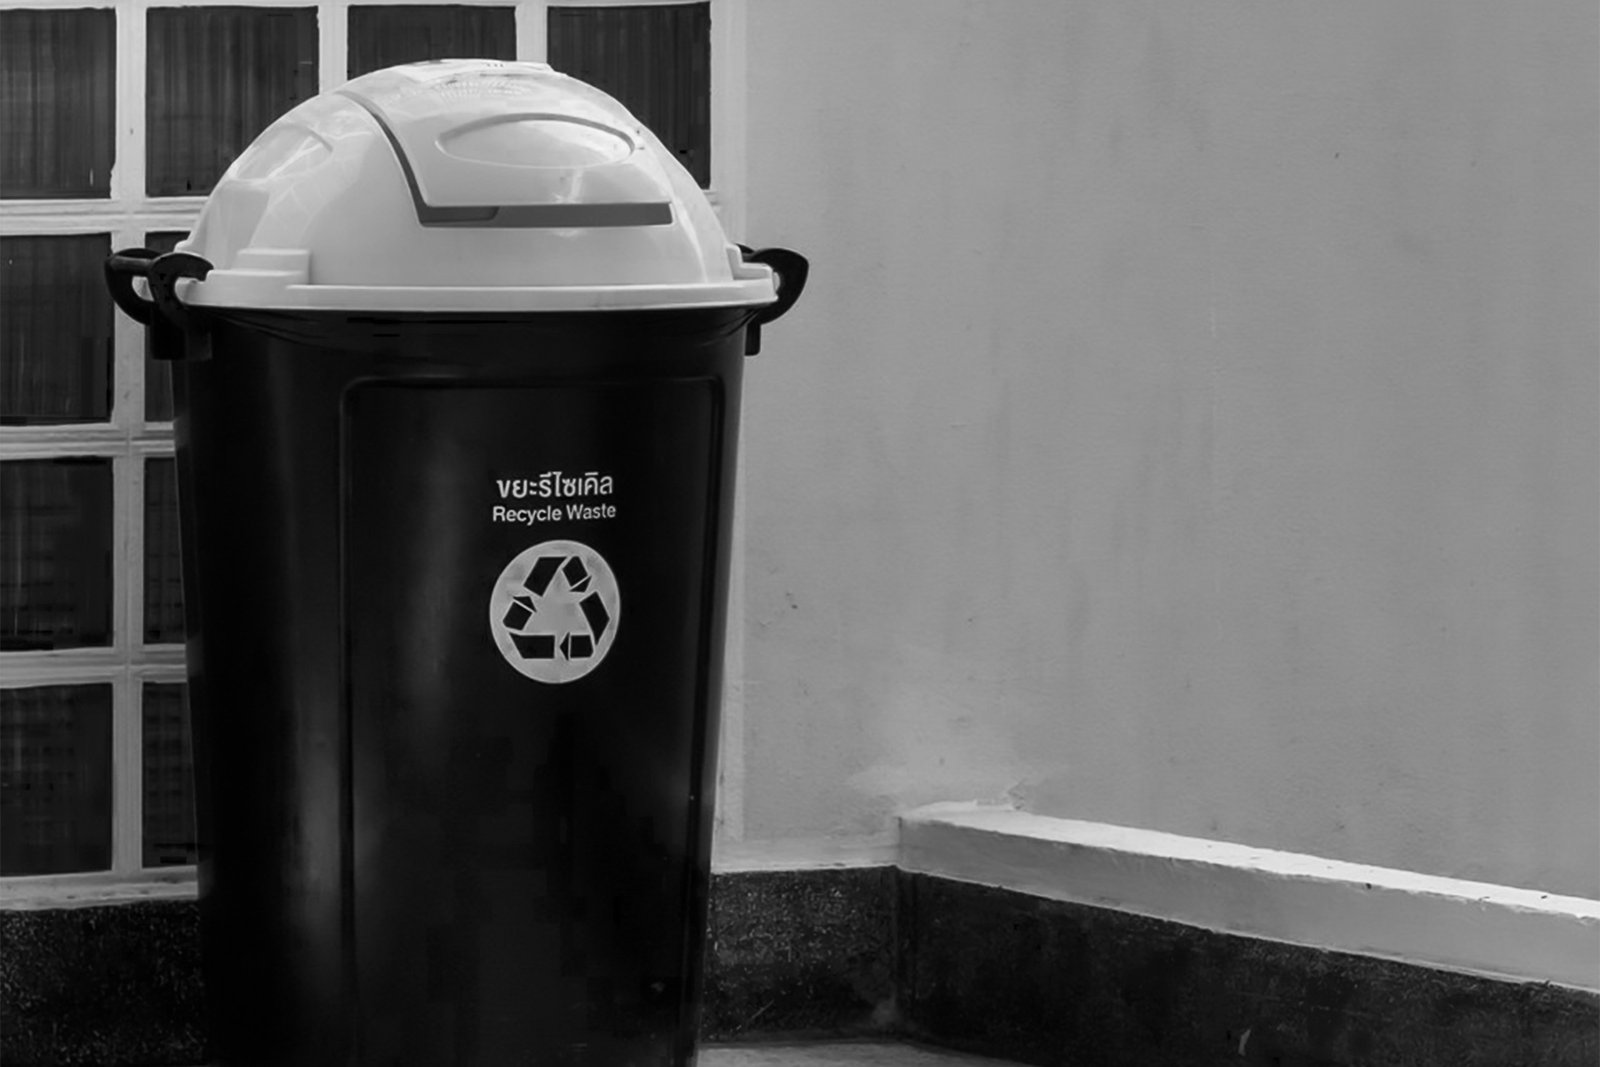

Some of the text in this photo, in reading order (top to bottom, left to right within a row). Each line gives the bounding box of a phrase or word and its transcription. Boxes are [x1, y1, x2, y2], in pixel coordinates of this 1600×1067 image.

[496, 471, 613, 498] ขยะรีไซเคิล
[492, 503, 616, 526] Recycle Waste
